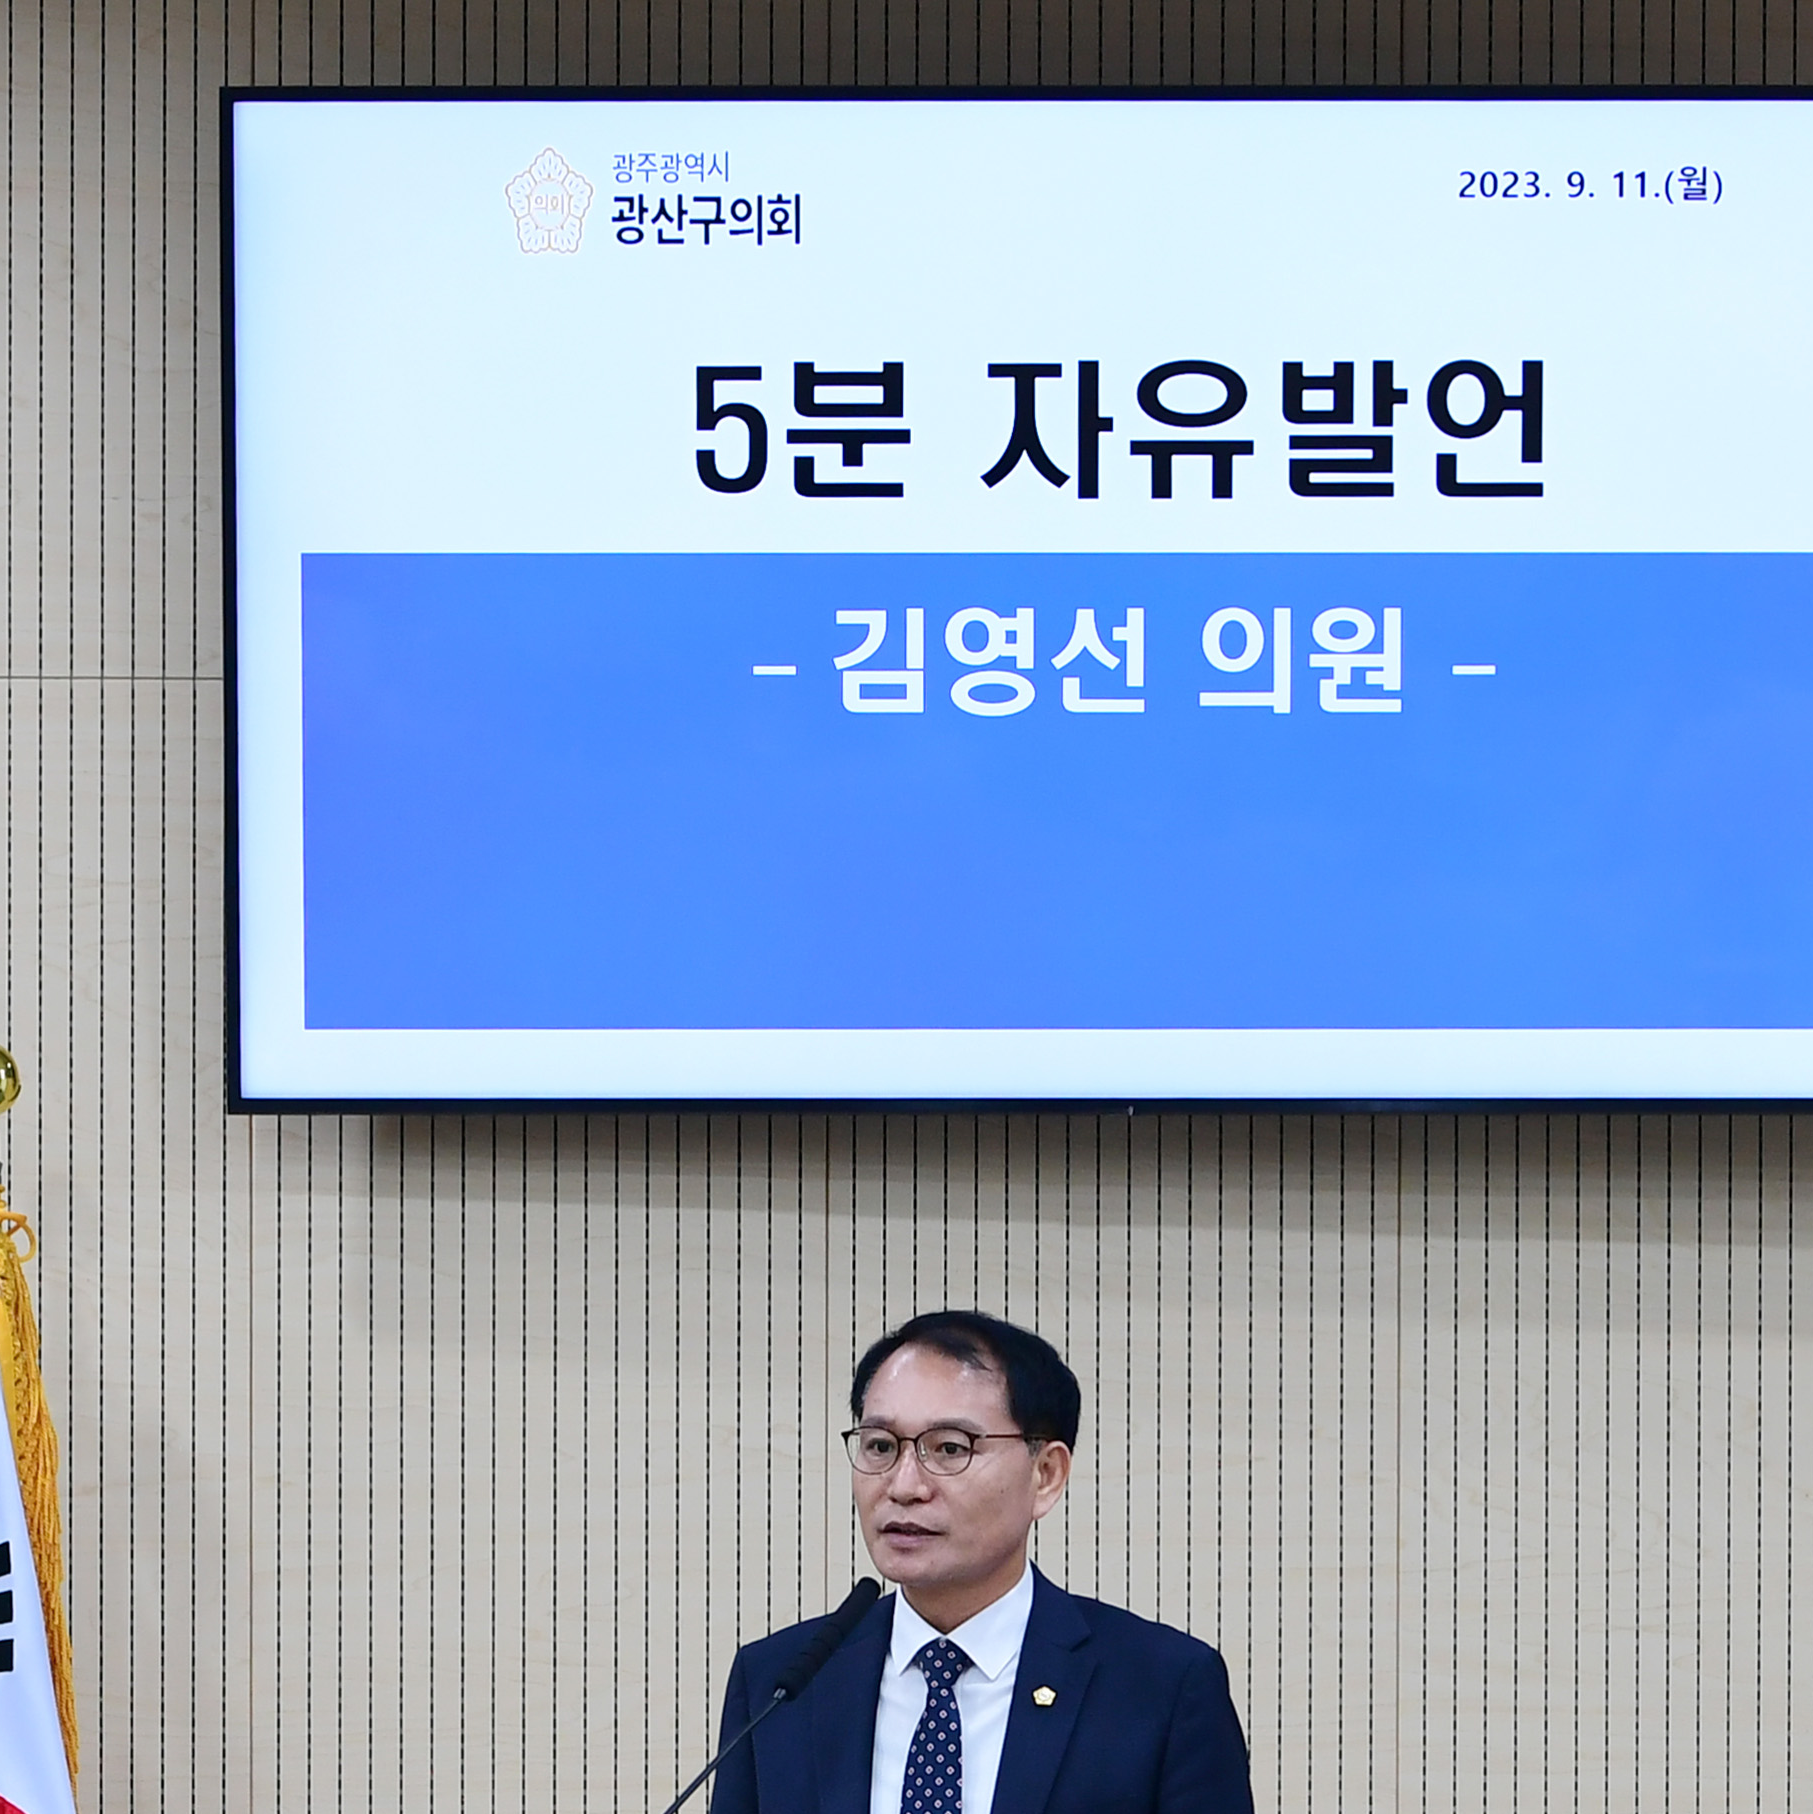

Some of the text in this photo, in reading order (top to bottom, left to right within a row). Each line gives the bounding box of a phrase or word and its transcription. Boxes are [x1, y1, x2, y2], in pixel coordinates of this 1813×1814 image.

[612, 150, 729, 184] 광주광역시
[1458, 165, 1723, 205] 2023. 9. 11.(월)
[611, 192, 801, 246] 광산구의회
[695, 358, 1544, 500] 5분 자유발언
[833, 607, 1145, 717] 김영선
[1199, 607, 1402, 714] 의원
